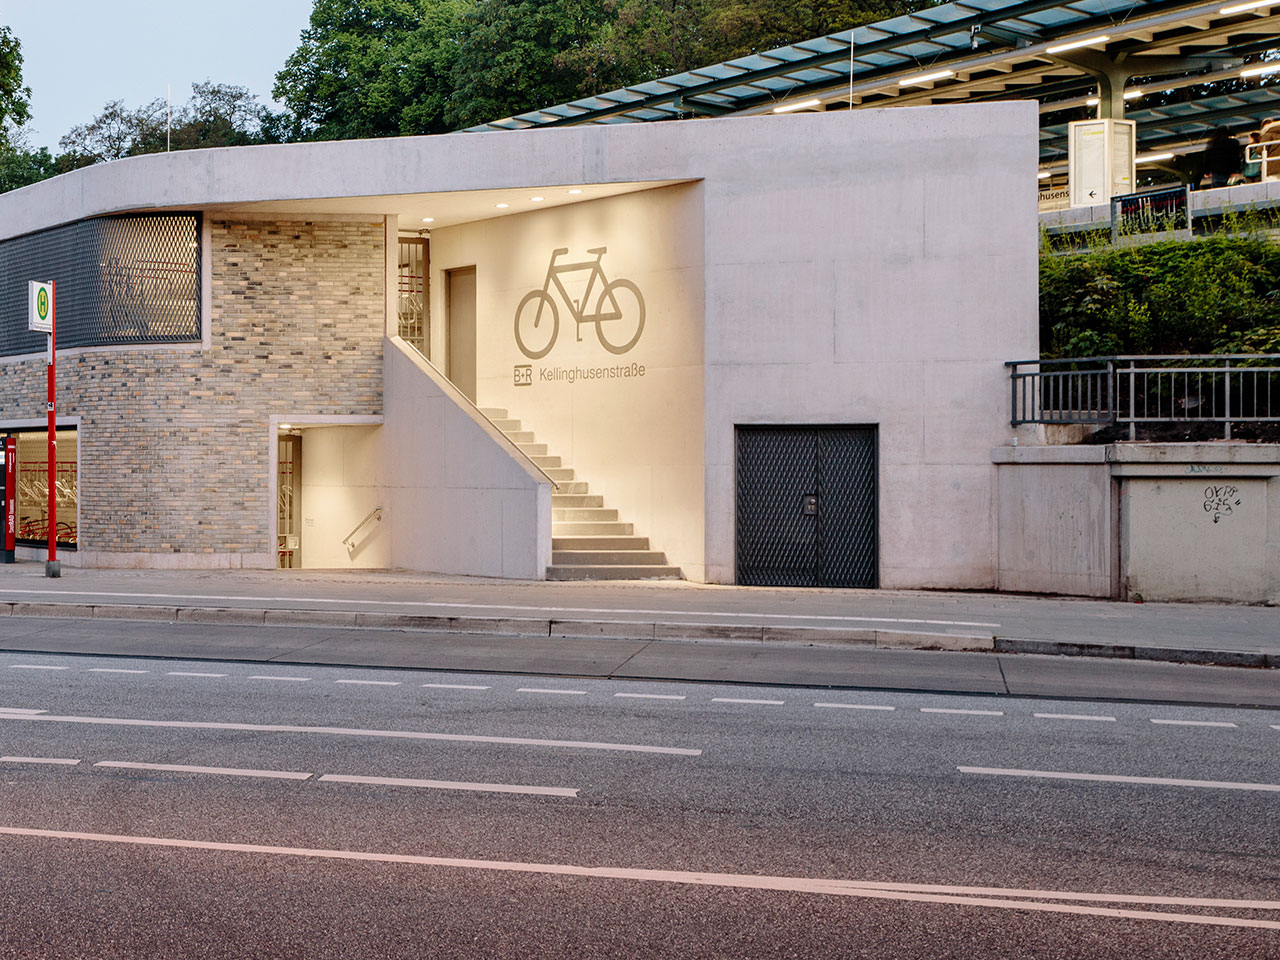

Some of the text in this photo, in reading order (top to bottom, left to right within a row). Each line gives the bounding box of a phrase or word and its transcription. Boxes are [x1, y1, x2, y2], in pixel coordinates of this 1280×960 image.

[1038, 191, 1070, 203] husens
[513, 362, 646, 384] B+R Kellinghusenstraße
